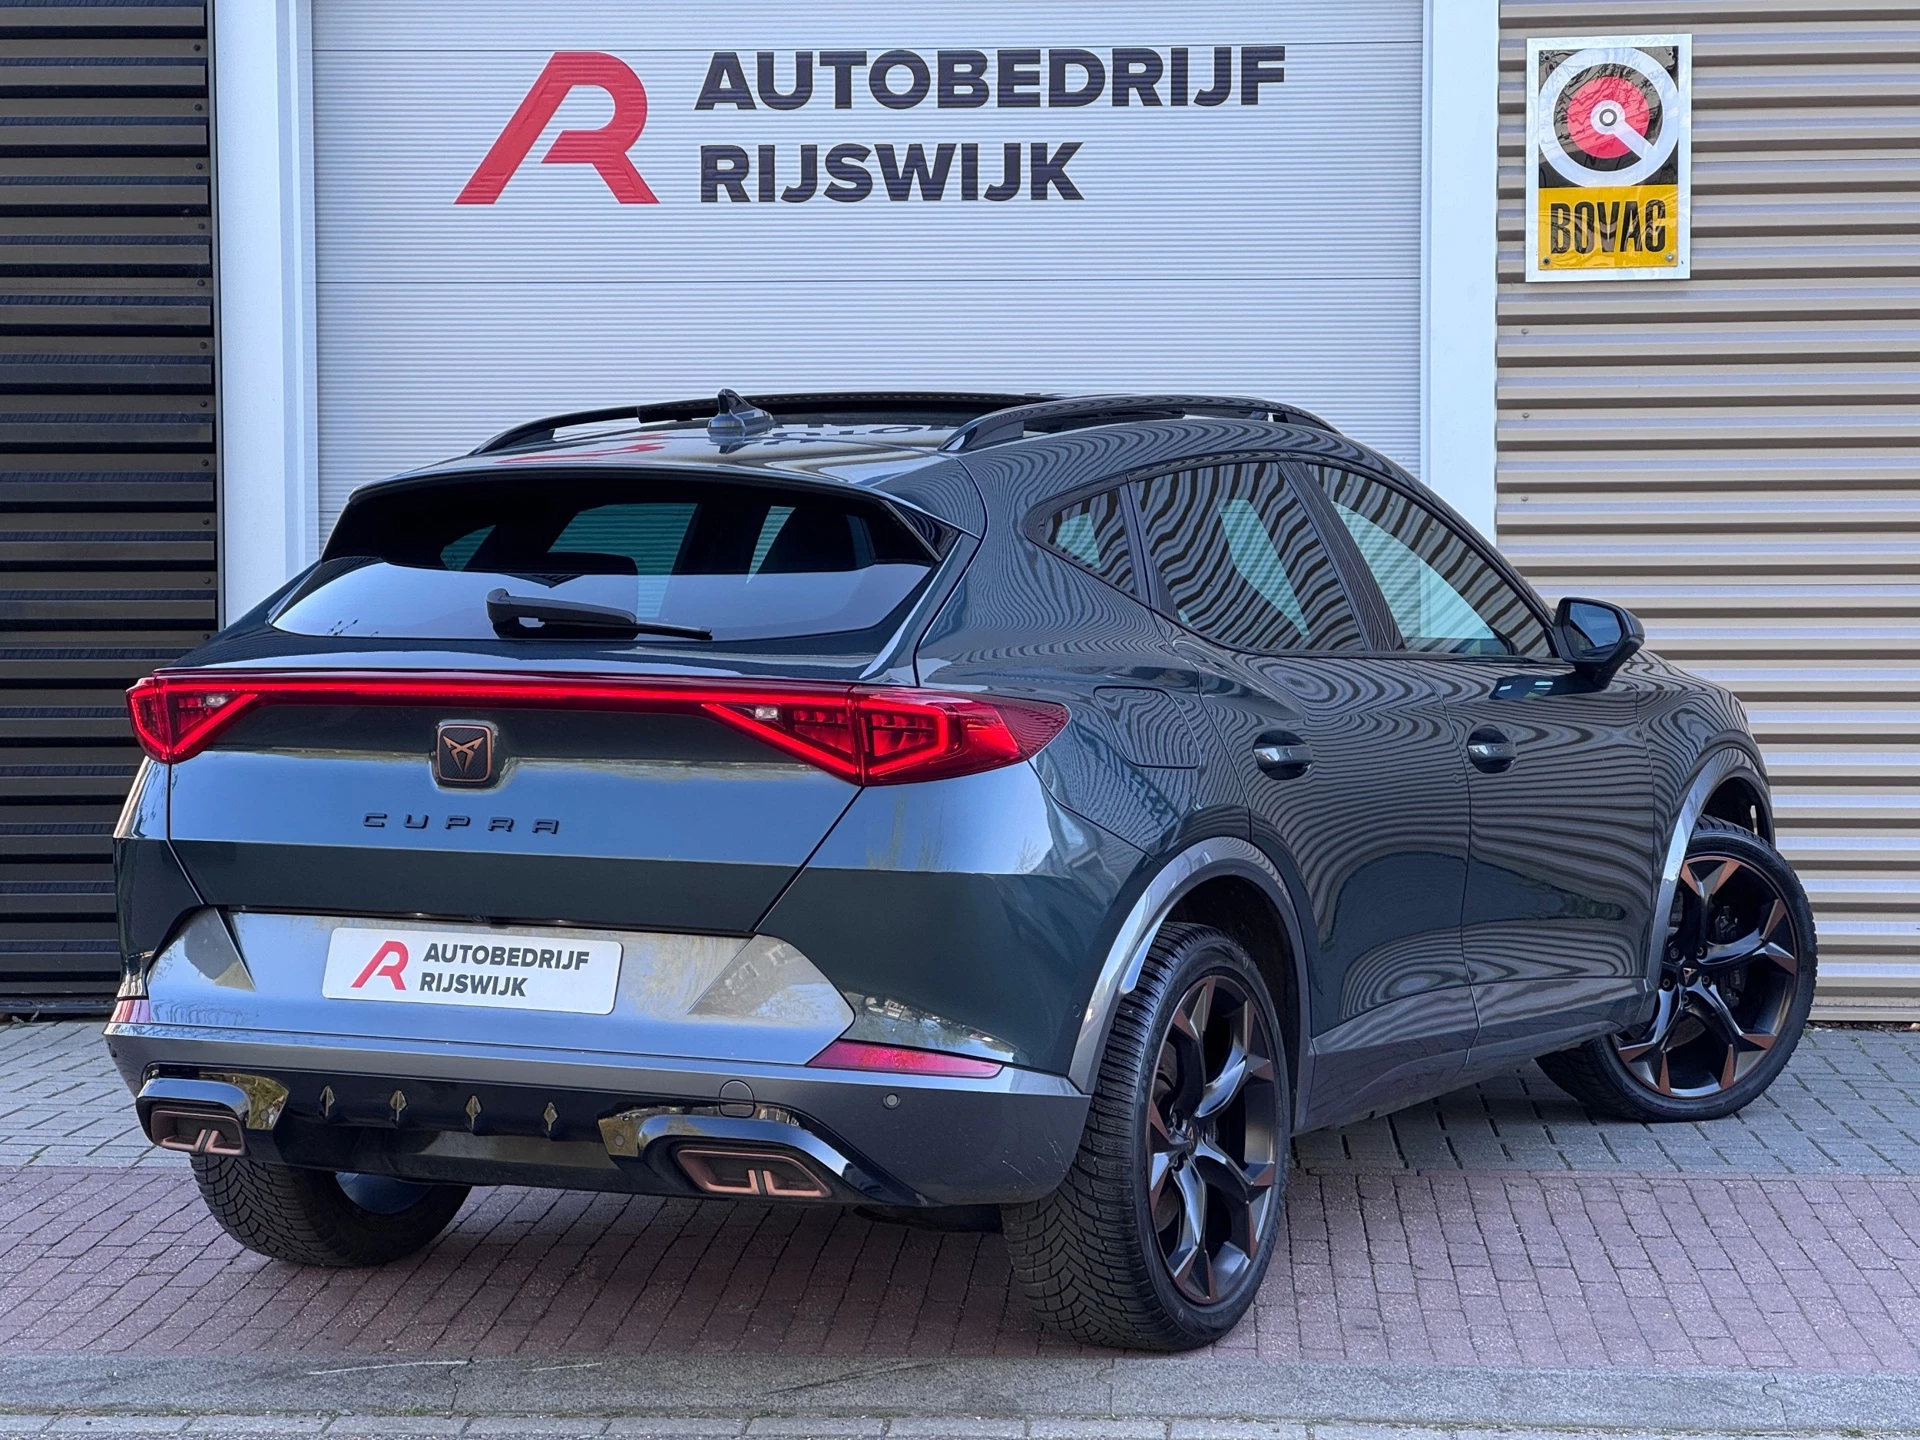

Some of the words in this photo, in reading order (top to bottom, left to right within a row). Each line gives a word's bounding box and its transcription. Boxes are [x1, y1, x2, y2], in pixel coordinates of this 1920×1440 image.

[695, 46, 1285, 111] AUTOBEDRIJF
[700, 142, 1084, 203] RIJSWIJK
[1550, 199, 1666, 254] BOVAG
[363, 812, 560, 834] CUPRA
[423, 943, 590, 971] AUTOBEDRIJF
[419, 972, 528, 997] RIJSWIJK
